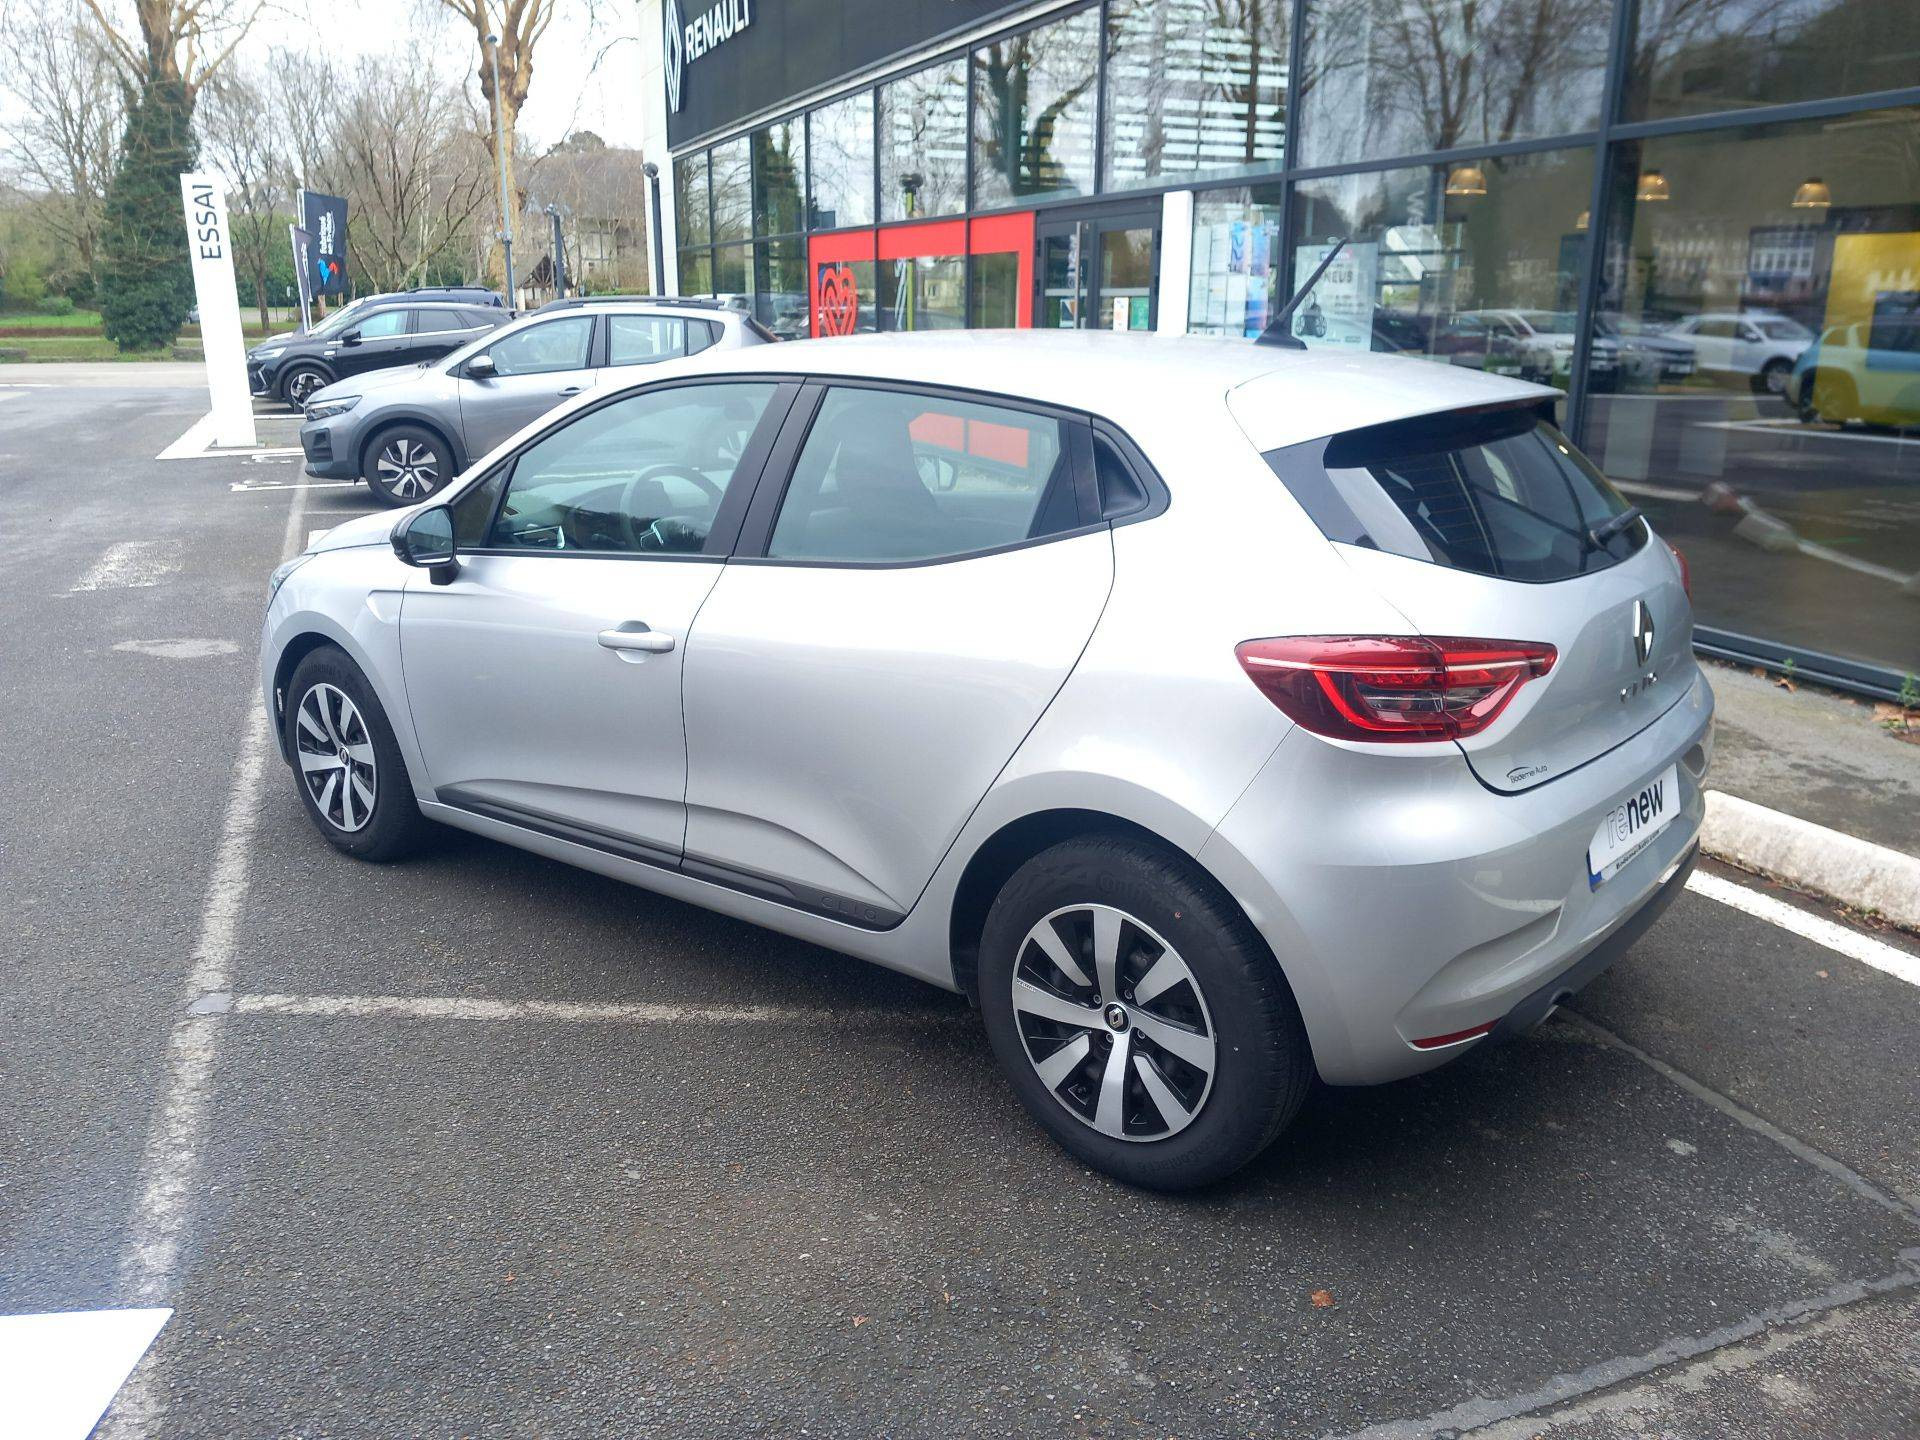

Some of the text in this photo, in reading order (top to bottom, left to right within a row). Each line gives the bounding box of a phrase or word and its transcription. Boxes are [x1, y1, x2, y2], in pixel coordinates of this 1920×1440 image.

[685, 0, 750, 64] RENAULT
[191, 184, 222, 259] ESSAI
[1606, 779, 1663, 849] renew
[820, 895, 878, 921] CLIO
